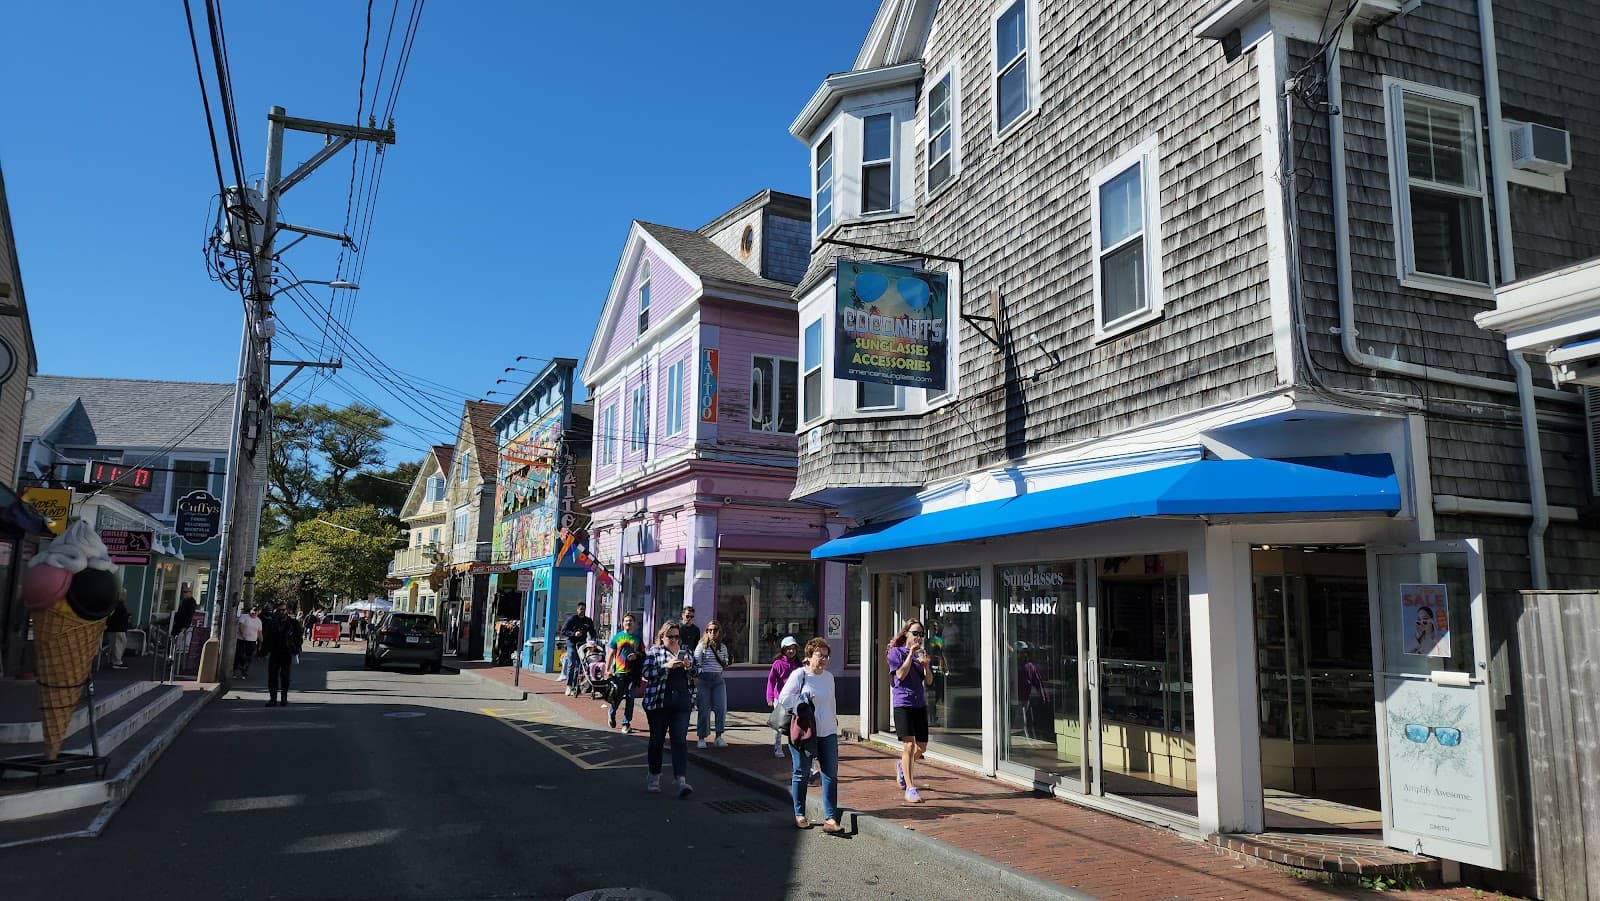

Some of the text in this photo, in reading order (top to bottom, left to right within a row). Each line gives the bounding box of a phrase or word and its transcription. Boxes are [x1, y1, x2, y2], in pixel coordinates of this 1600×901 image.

[843, 306, 943, 343] COCONUTS
[855, 337, 928, 356] SUNGLASSES
[852, 353, 930, 371] ACCESSORIES
[703, 349, 713, 419] TATTOO
[927, 568, 1064, 592] Prescription Sunglasses
[935, 596, 1058, 617] Eyewear Est. 1987
[1403, 594, 1443, 607] SALE
[1402, 784, 1432, 798] Amplify
